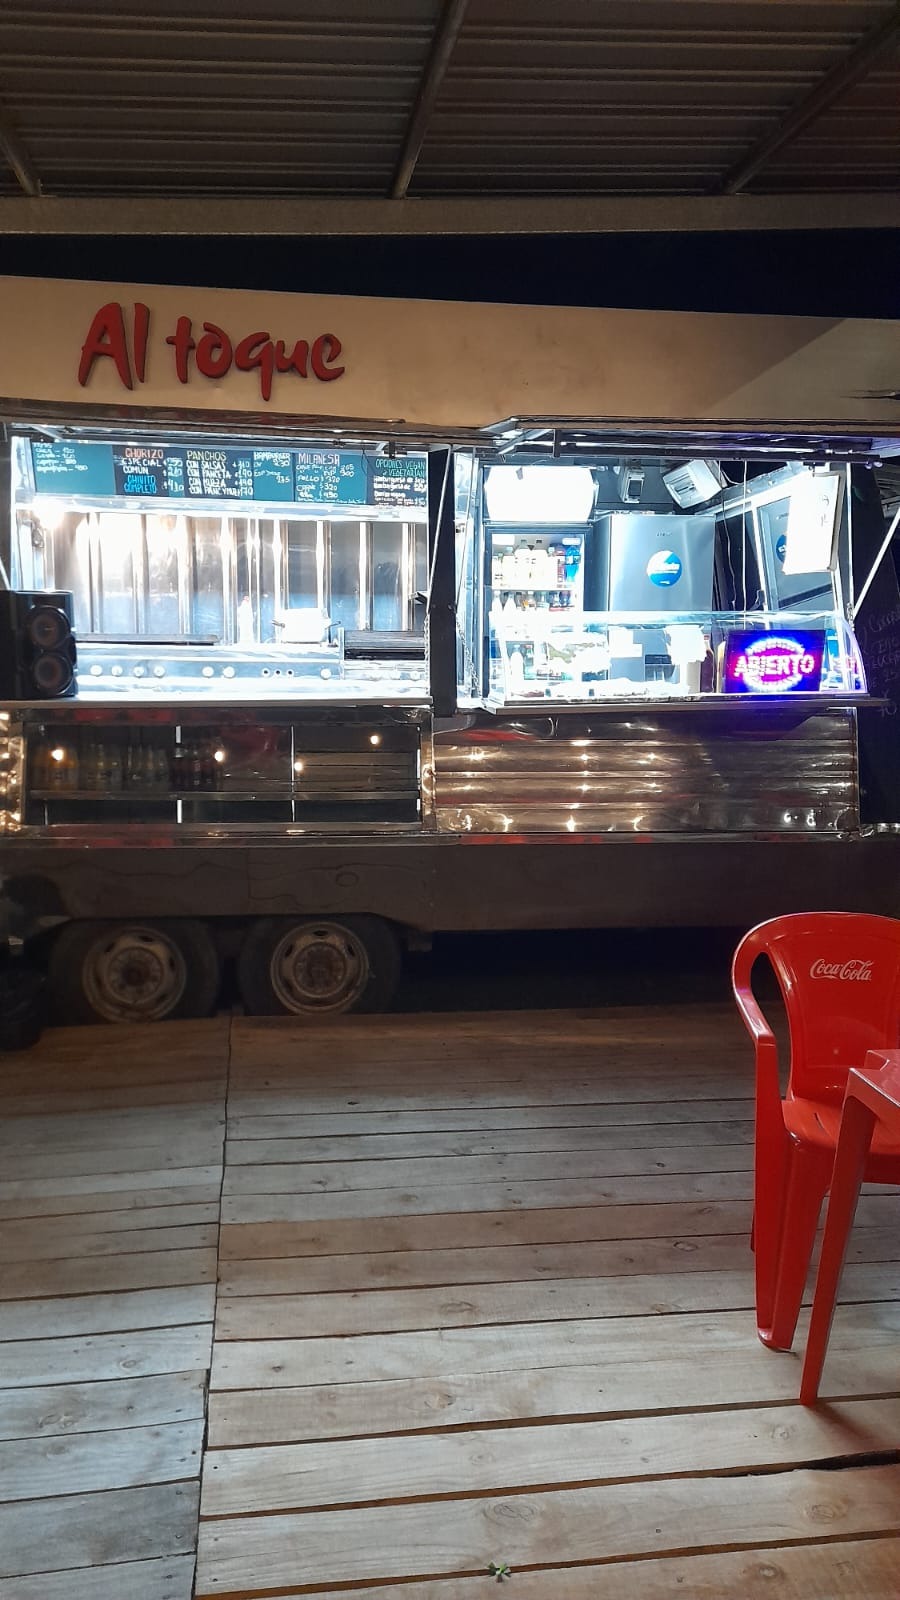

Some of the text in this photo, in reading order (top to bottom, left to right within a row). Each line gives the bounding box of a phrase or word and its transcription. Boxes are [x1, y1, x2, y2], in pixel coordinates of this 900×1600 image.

[78, 302, 345, 402] Al toque
[125, 448, 163, 459] CHORIZO
[187, 450, 226, 461] PANCHOS
[121, 458, 162, 467] ESPECIAL
[186, 460, 198, 468] CON
[201, 460, 226, 470] SALSAS
[298, 453, 340, 466] MILANESA
[187, 468, 199, 476] CON
[202, 469, 232, 479] PANCETA
[734, 654, 815, 677] ABIERTO
[809, 958, 874, 980] Coca-Cola
